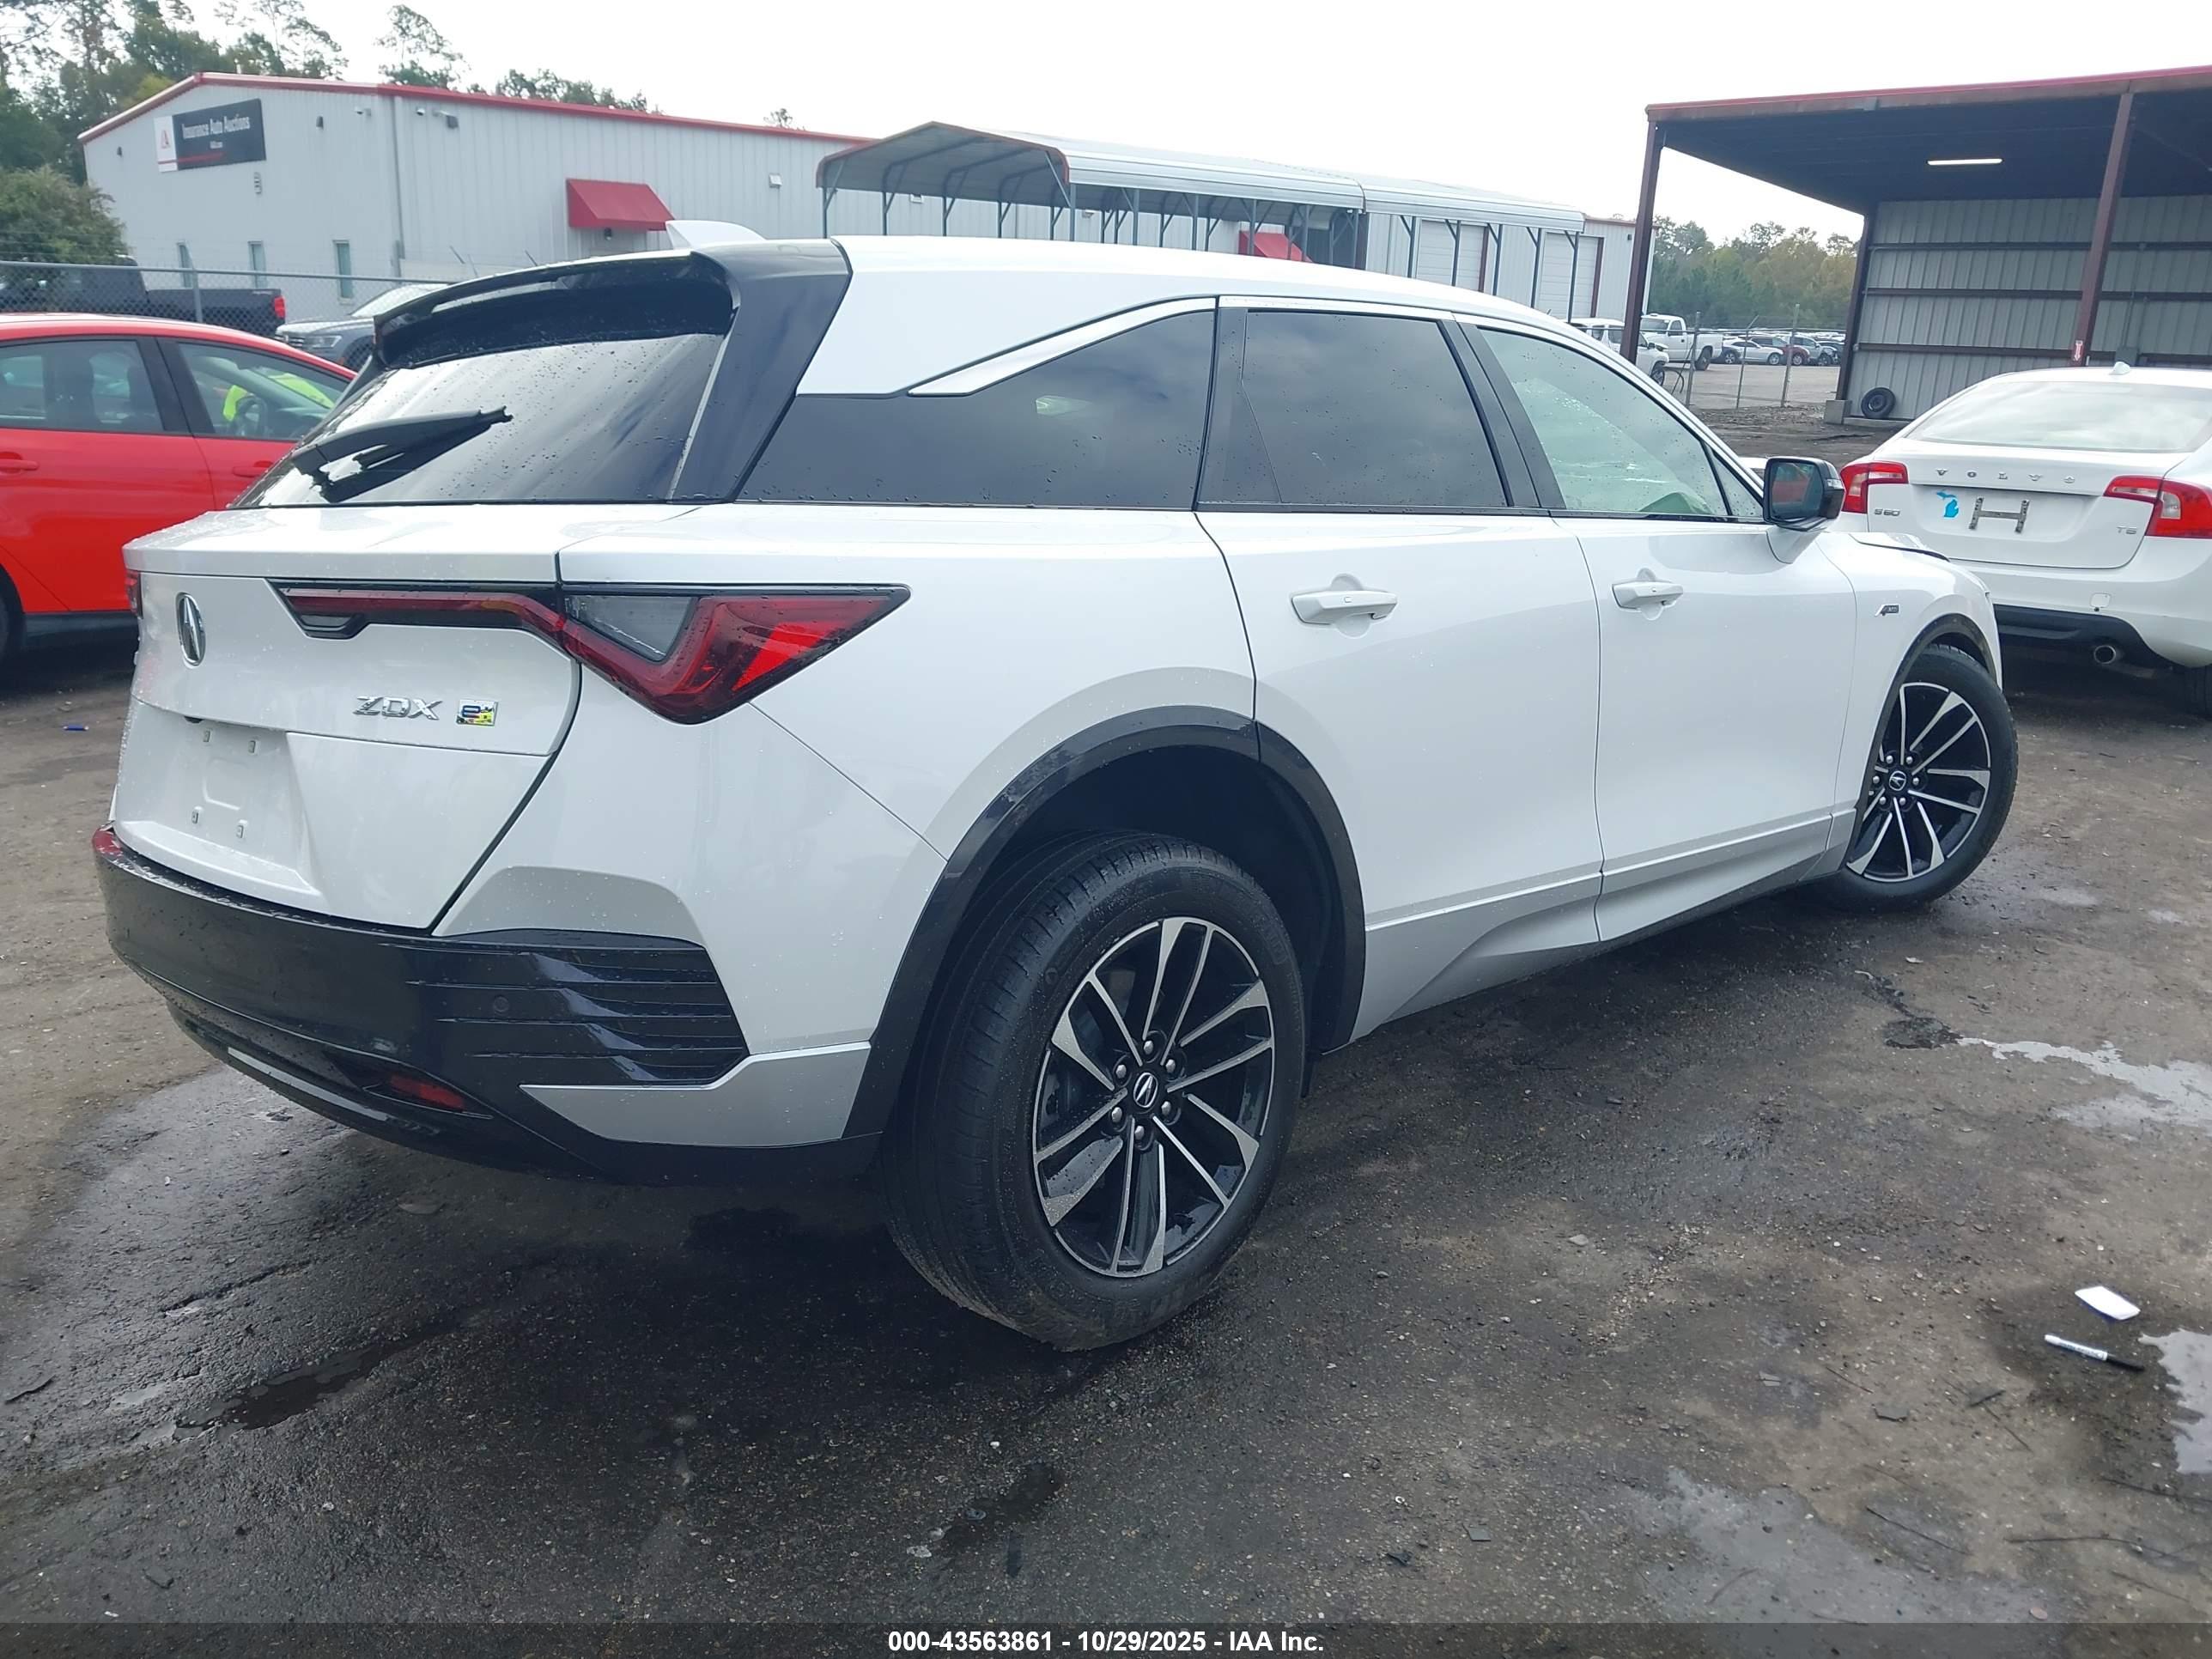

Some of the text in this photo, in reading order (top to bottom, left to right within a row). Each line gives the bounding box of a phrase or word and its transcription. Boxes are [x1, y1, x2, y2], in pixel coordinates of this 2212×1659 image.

[1936, 468, 2075, 484] VOLVO
[1874, 508, 1900, 517] S60
[352, 696, 443, 721] ZDX
